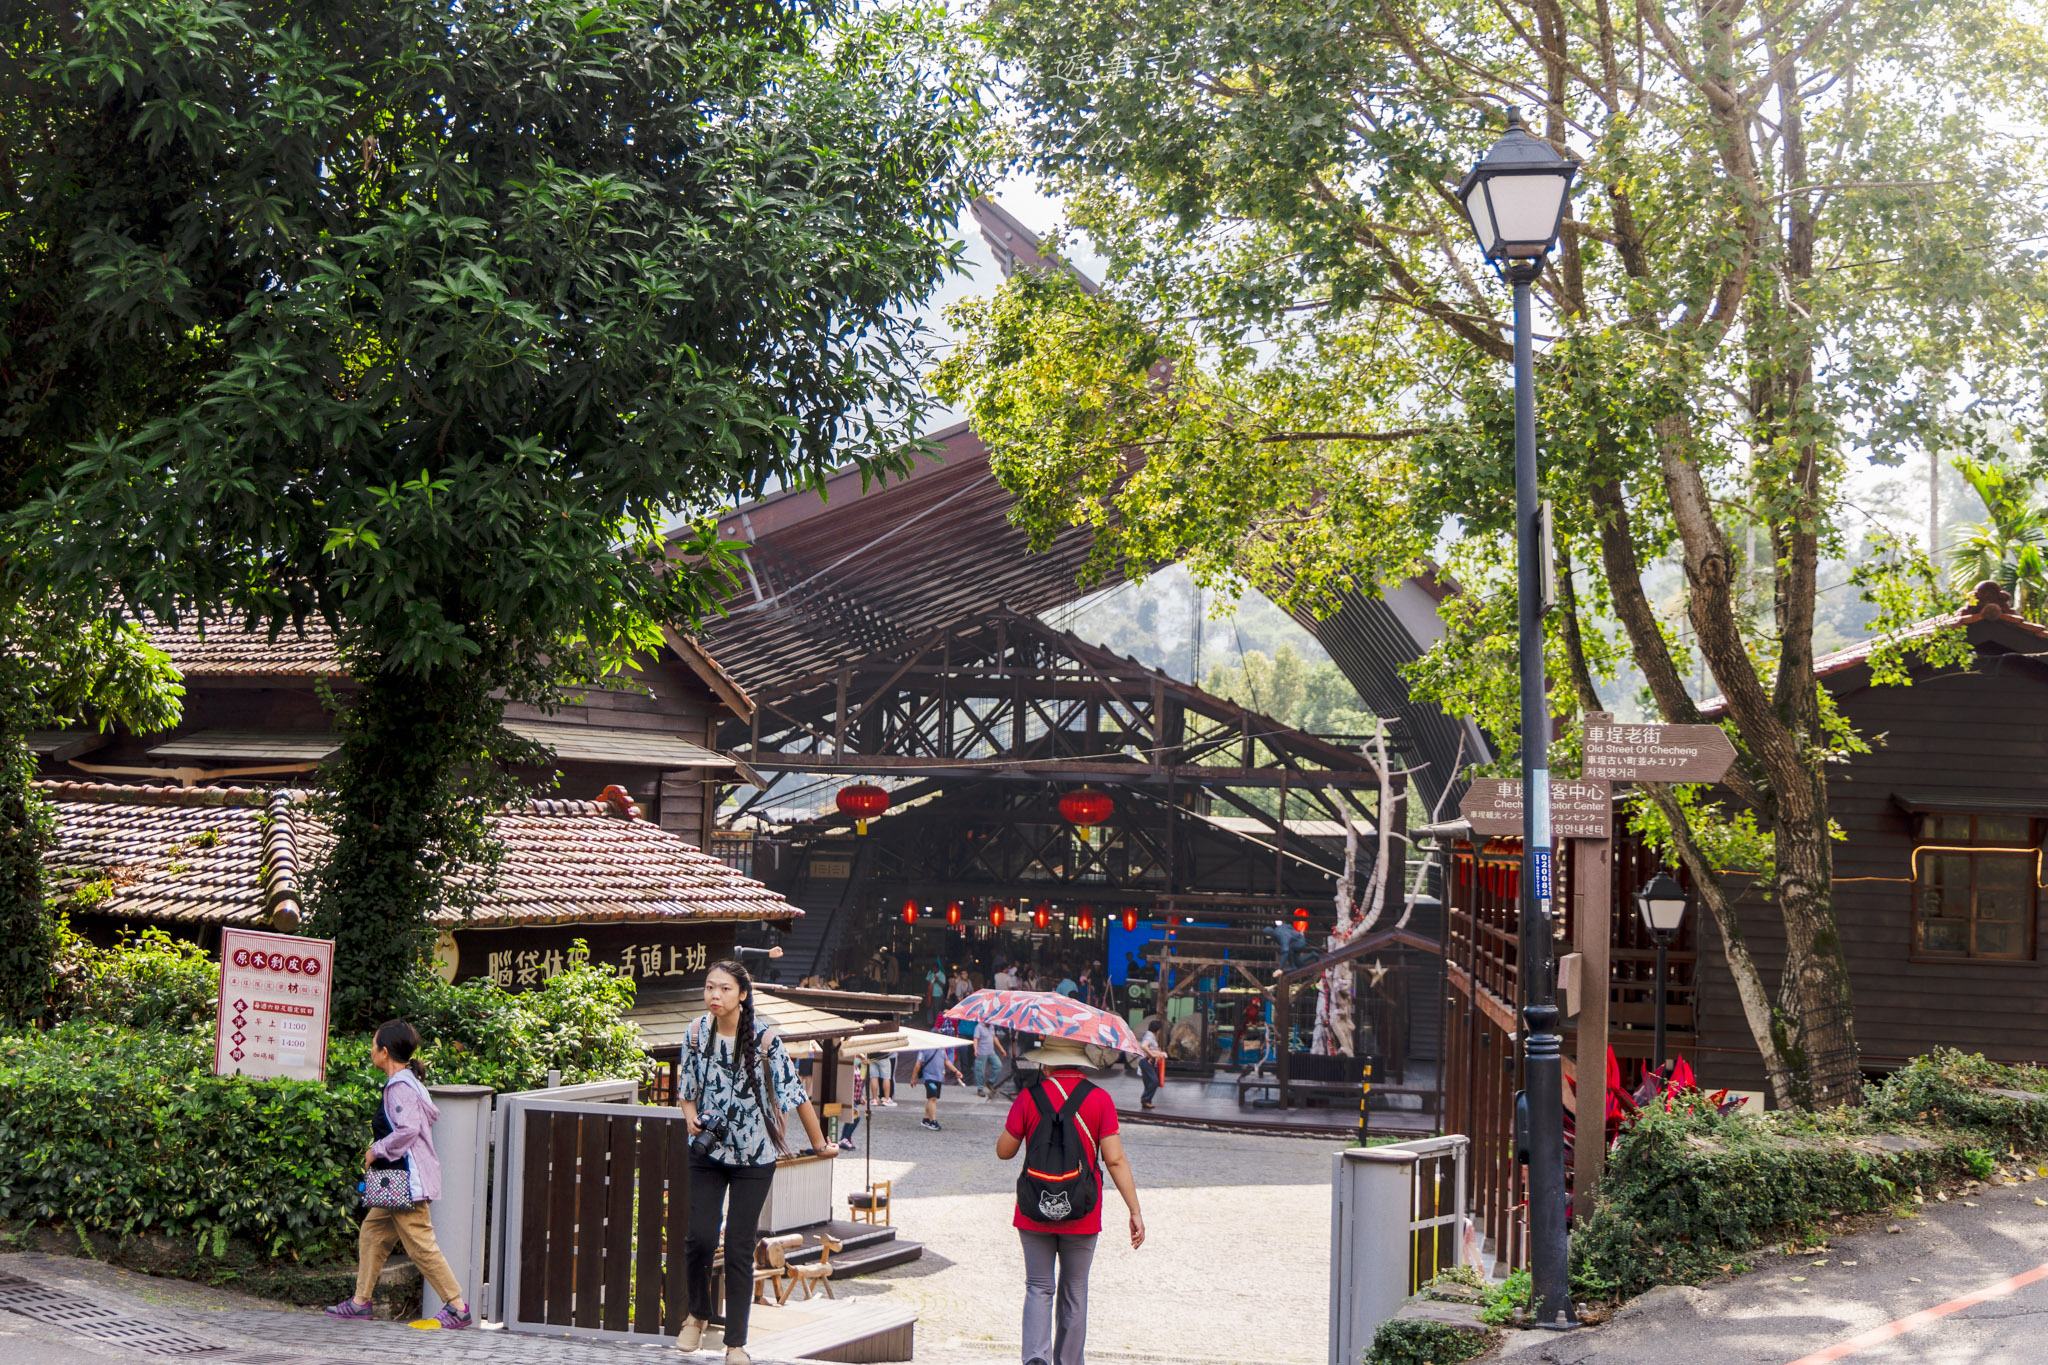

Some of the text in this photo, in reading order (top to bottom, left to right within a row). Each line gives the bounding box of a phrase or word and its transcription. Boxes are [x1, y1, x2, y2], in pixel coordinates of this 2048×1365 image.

[1587, 726, 1662, 744] 車埕老街
[1587, 744, 1698, 756] Old Street Of Checheng
[1549, 801, 1572, 810] isitor
[1573, 802, 1605, 811] Center
[1540, 854, 1548, 896] 020082
[618, 942, 708, 978] 舌頭上班
[283, 1021, 307, 1031] 11:00
[254, 1035, 305, 1048] 下午 14:00
